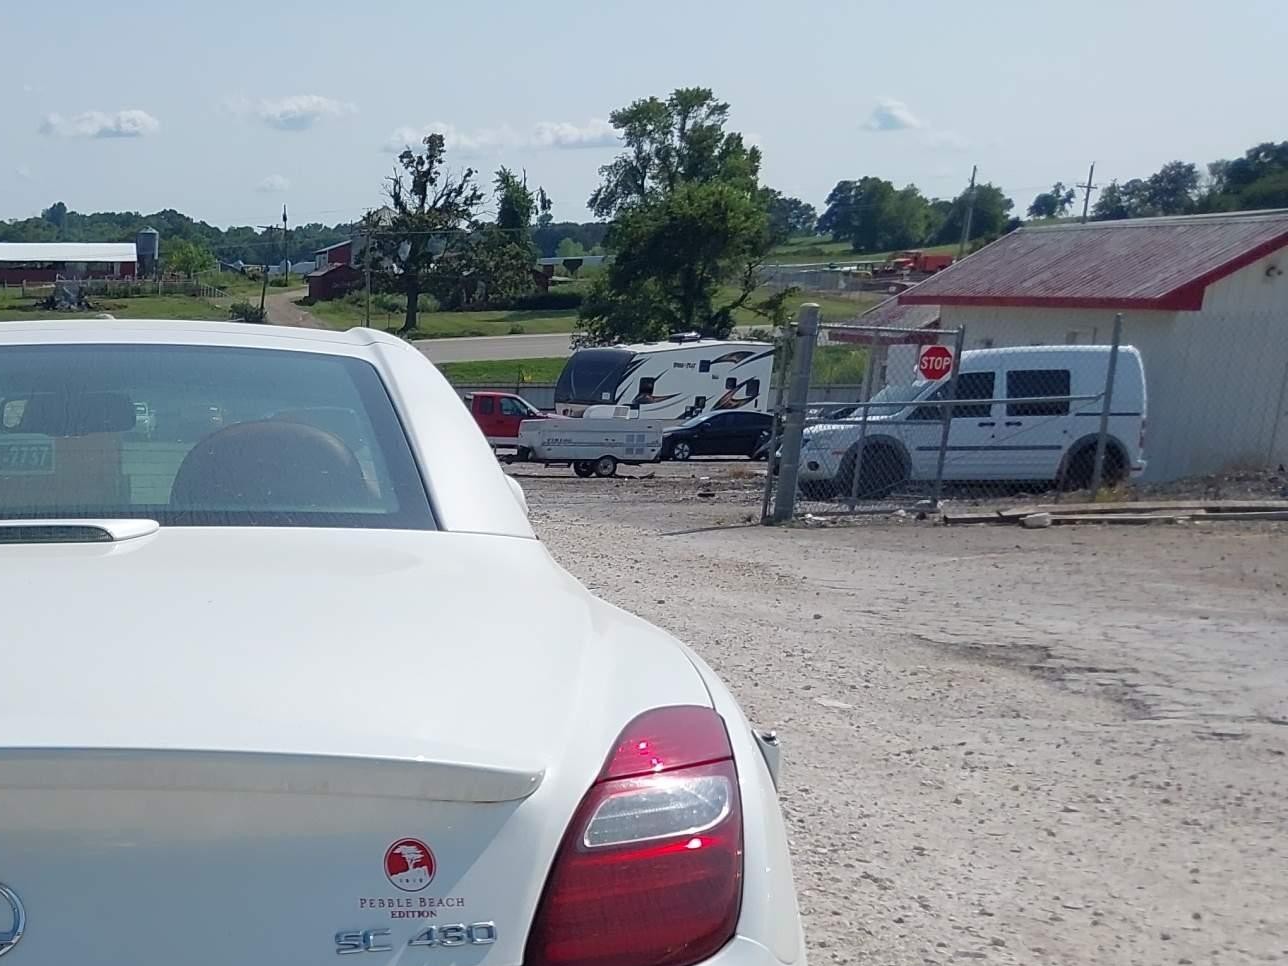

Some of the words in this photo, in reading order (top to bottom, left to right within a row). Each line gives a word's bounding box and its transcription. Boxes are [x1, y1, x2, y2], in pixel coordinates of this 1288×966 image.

[920, 356, 951, 370] STOP
[359, 898, 413, 908] PEBBLE
[419, 897, 465, 908] BEACH
[391, 910, 437, 919] EDITION
[334, 927, 393, 955] SC
[408, 920, 498, 948] 430
